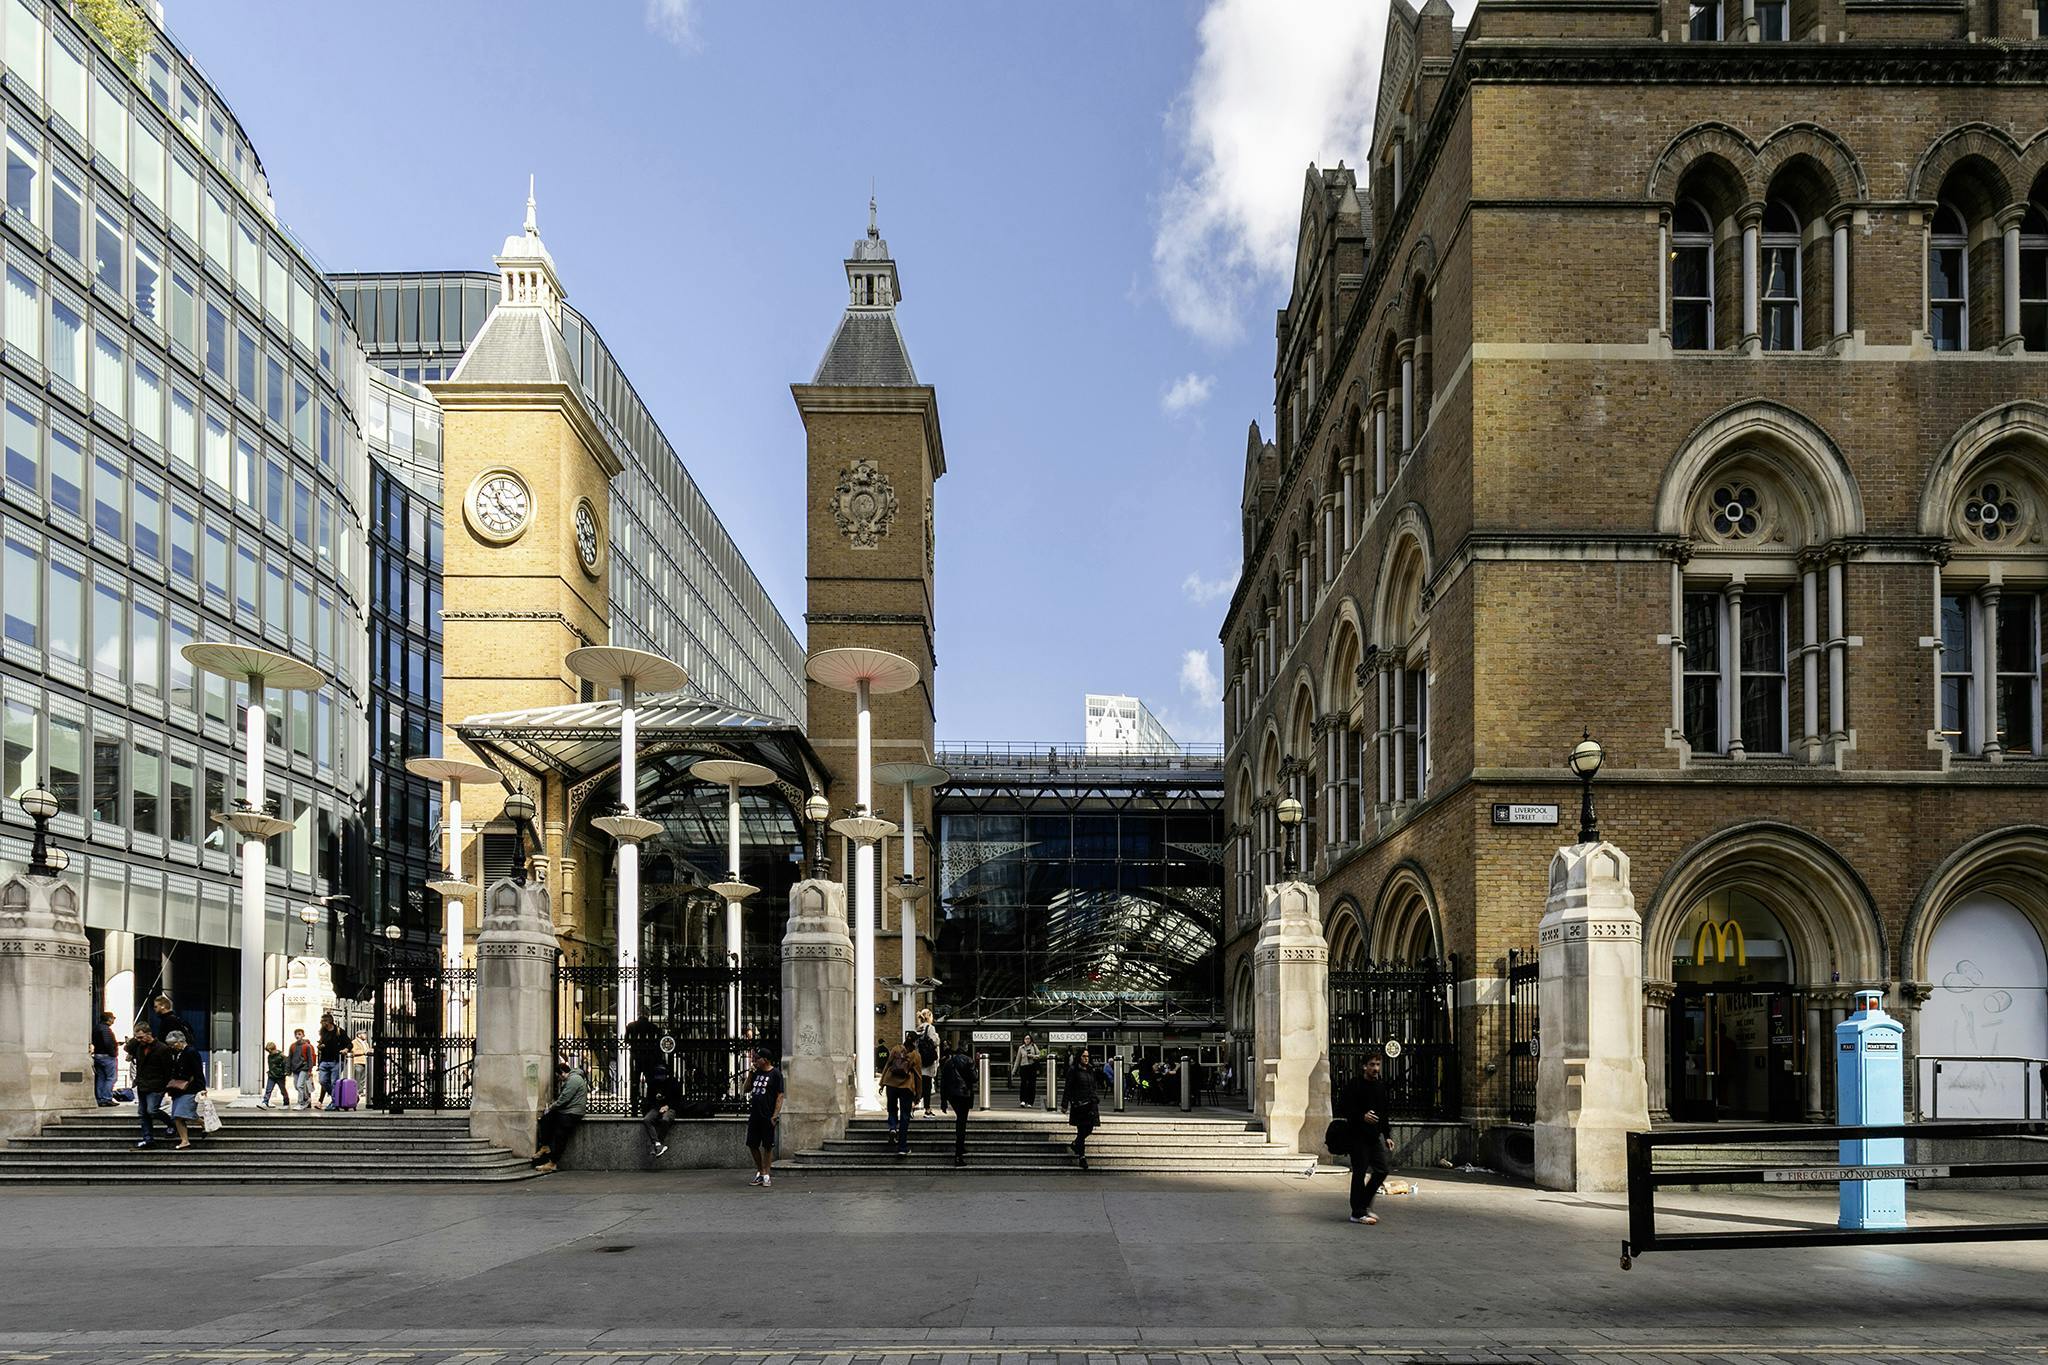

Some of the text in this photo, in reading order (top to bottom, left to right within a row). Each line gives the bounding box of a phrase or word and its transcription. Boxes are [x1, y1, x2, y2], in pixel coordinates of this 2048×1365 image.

[1726, 992, 1764, 1012] WELCOME
[1050, 1033, 1086, 1041] M&S FOOD
[1788, 1168, 1926, 1180] FIRE GATE DO NOT OBSTRUCT
